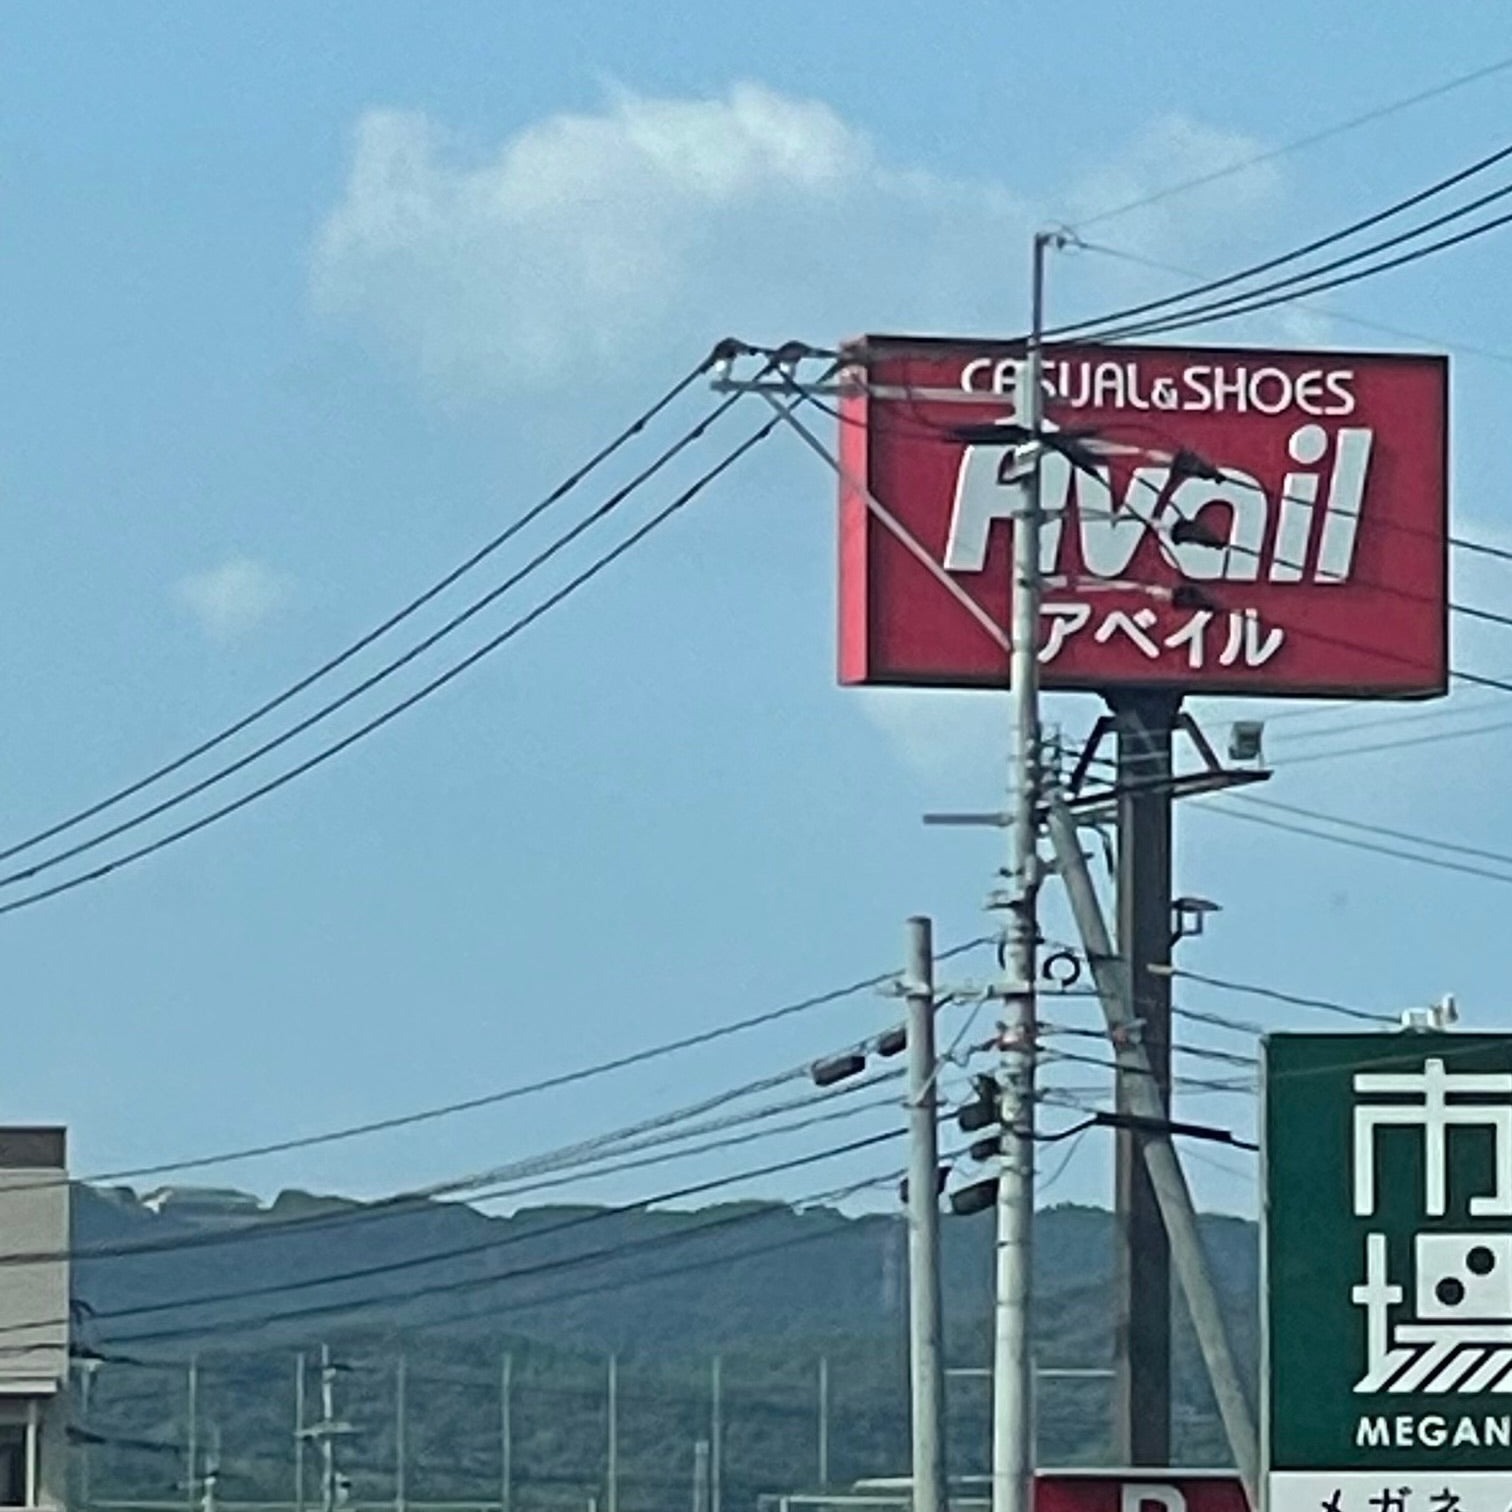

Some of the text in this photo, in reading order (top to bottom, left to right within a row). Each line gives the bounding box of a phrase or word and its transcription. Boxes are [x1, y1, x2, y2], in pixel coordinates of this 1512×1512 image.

[943, 424, 1373, 583] Avail
[1038, 603, 1284, 668] アベイル
